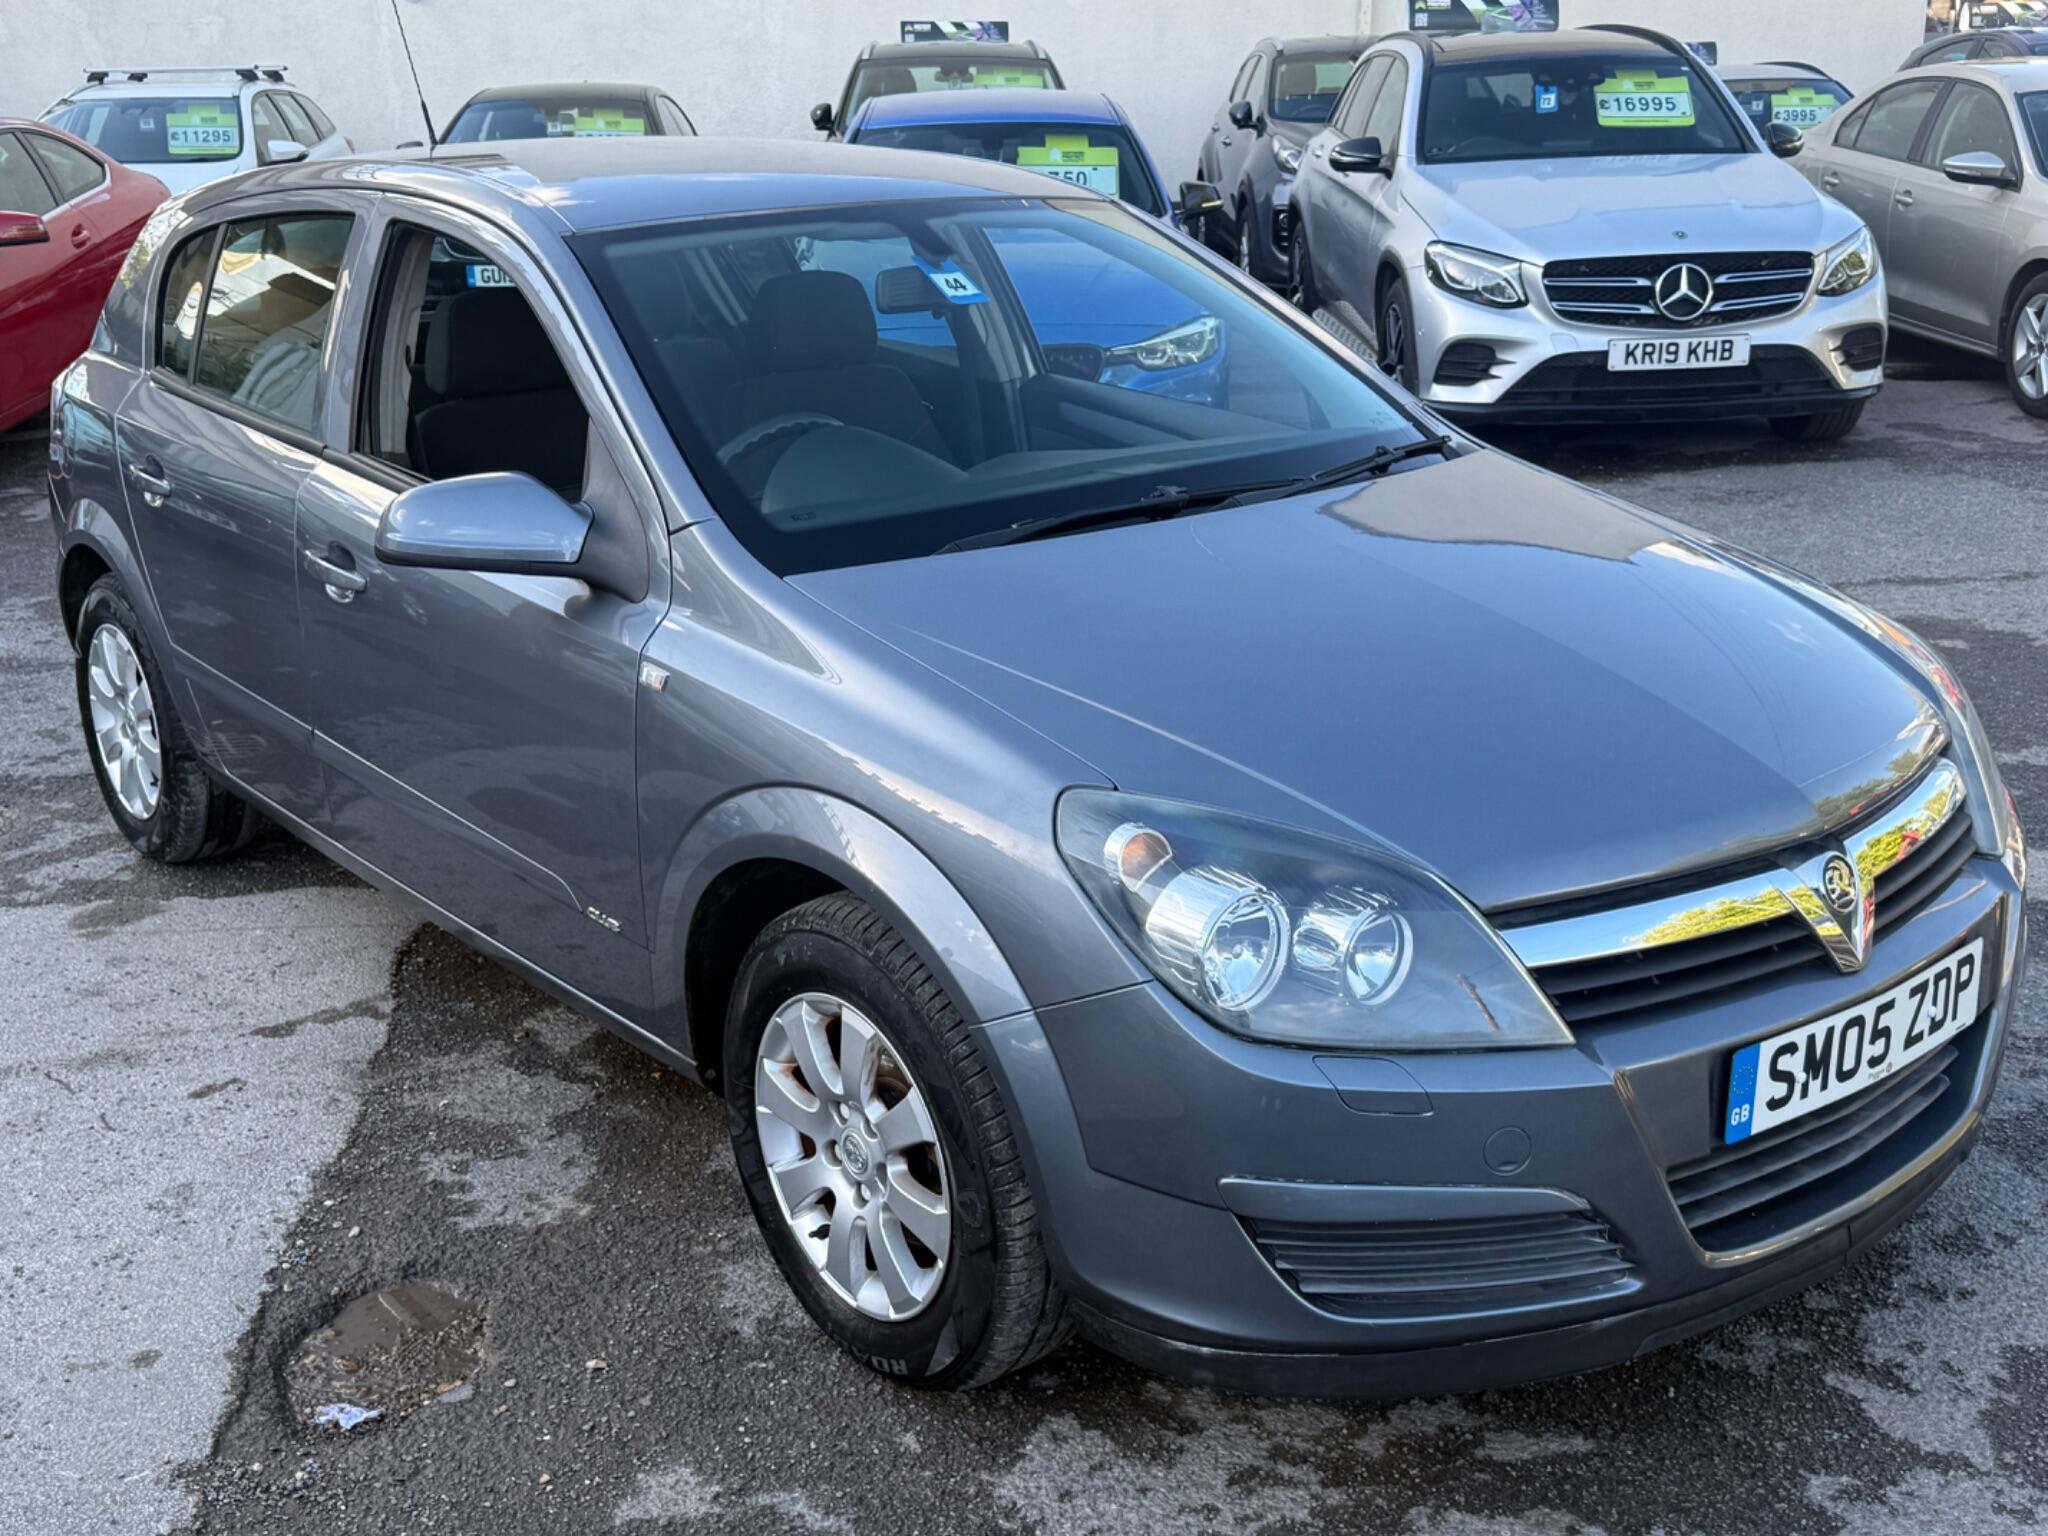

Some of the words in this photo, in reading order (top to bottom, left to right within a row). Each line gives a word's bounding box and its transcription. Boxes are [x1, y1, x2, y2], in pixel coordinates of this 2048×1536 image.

[1599, 96, 1677, 112] £16995
[1774, 109, 1817, 122] £3995
[170, 129, 231, 142] £11295
[1624, 342, 1680, 366] KR19
[1686, 339, 1734, 364] KHB
[1765, 996, 1896, 1112] SM05
[1903, 952, 1975, 1052] ZDP
[1730, 1103, 1751, 1127] GB
